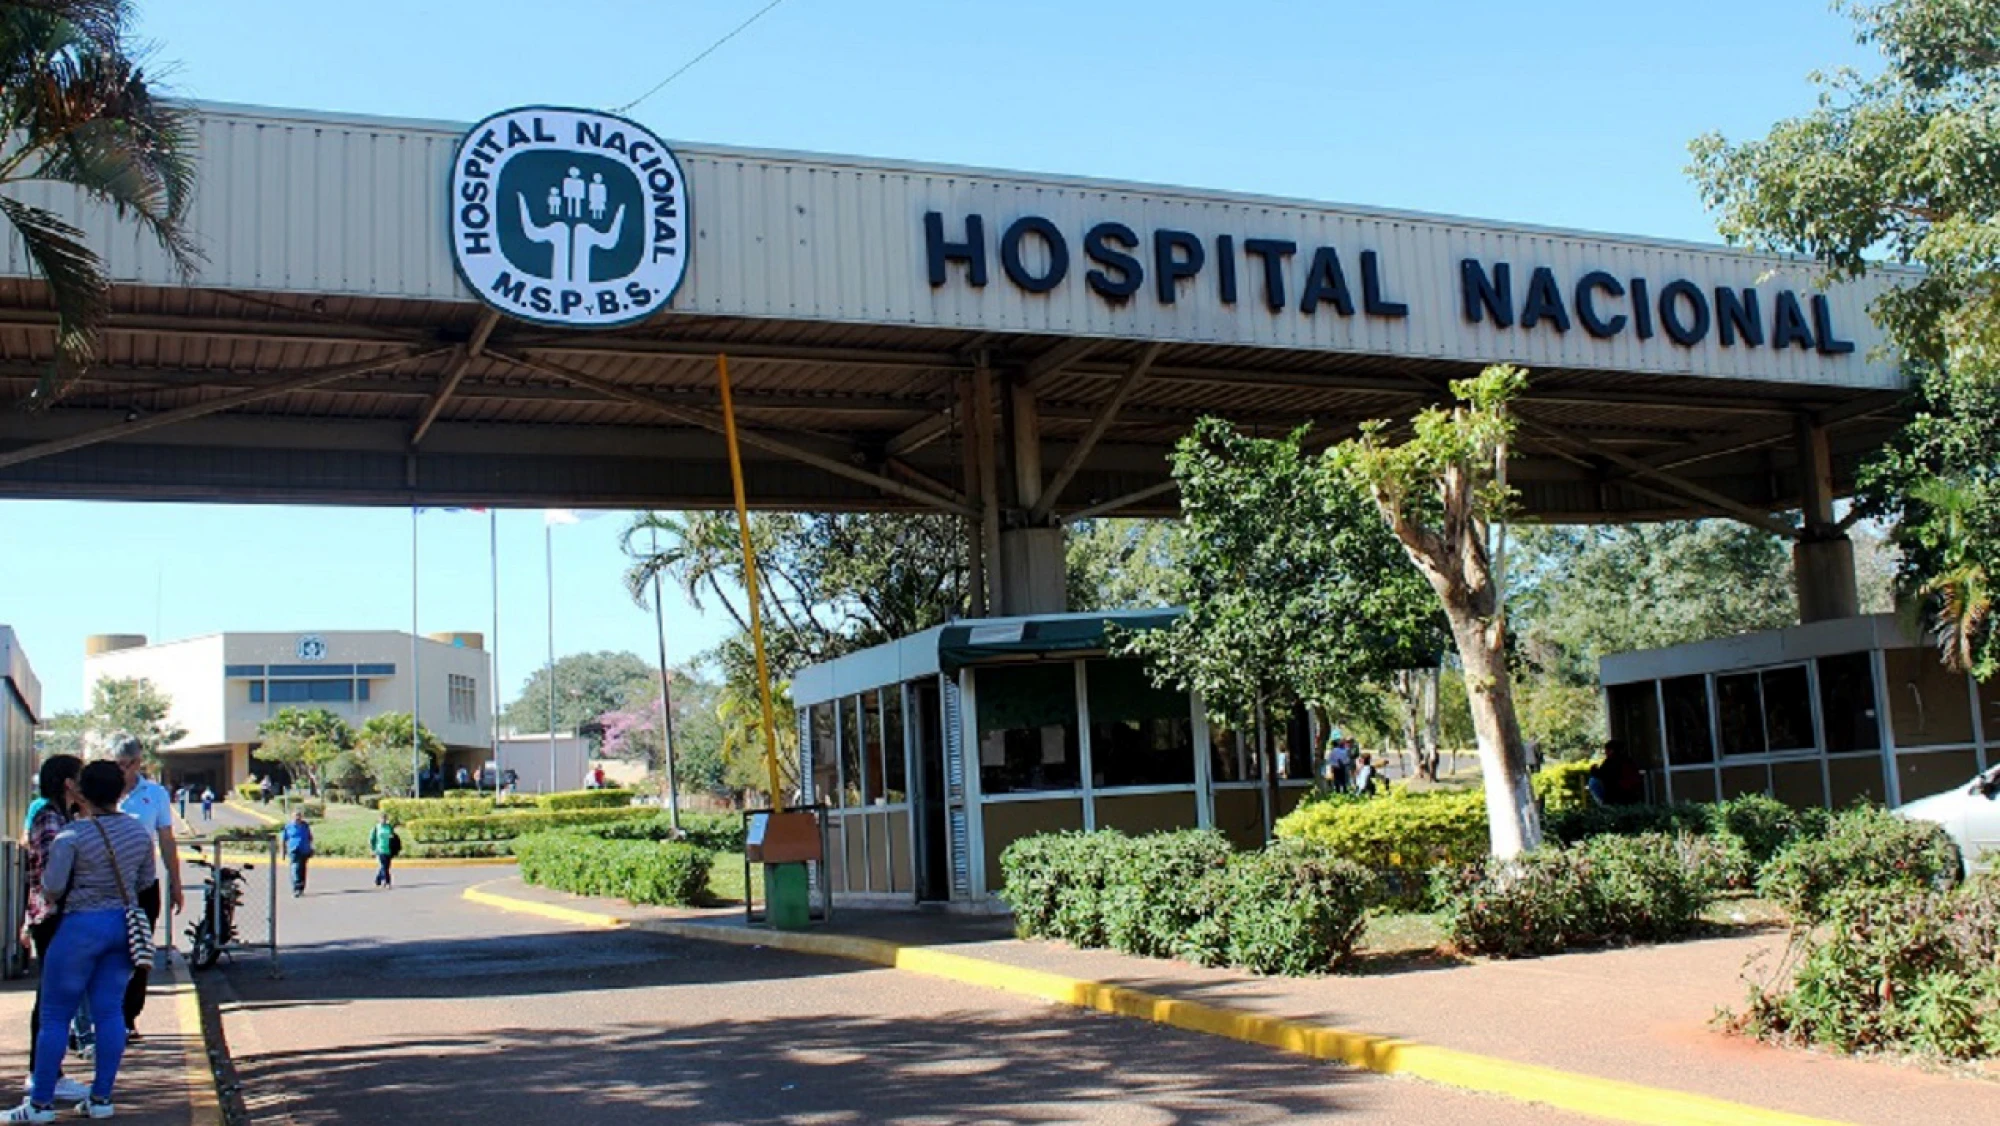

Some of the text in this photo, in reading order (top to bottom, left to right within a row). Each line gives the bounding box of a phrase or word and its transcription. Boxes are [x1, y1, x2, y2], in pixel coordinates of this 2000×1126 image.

[460, 118, 677, 264] HOSPITAL NACIONAL
[924, 211, 1855, 354] HOSPITAL NACIONAL
